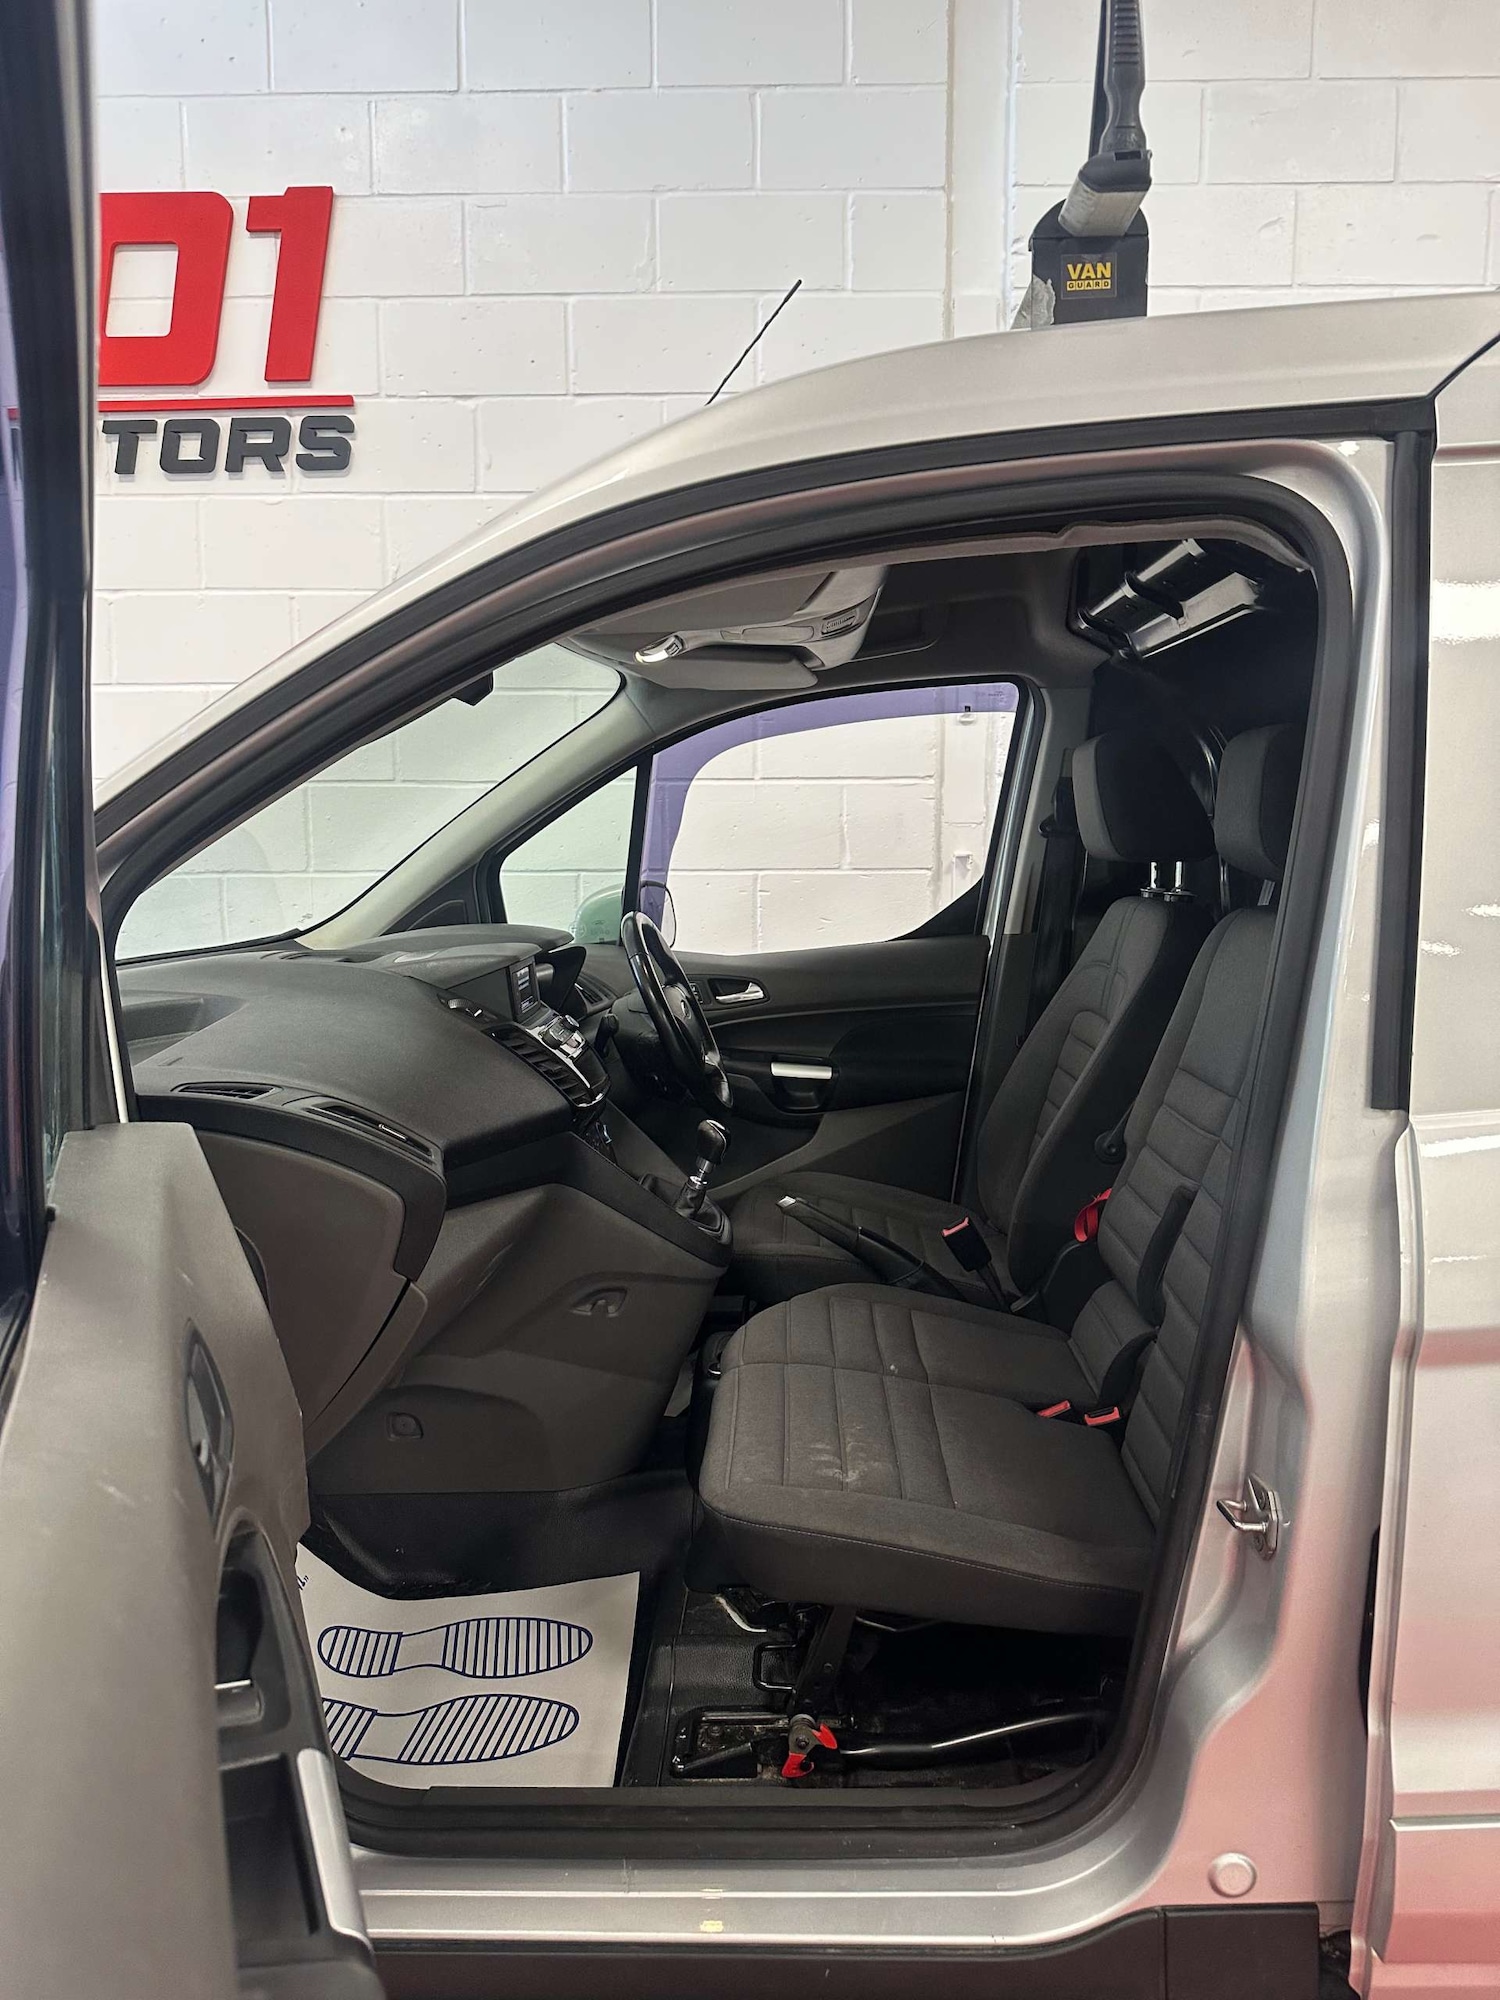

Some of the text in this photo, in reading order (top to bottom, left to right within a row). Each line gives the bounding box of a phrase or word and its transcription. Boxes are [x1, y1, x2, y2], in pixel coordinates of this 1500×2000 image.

[1067, 262, 1111, 279] VAN
[1067, 280, 1111, 290] GUARD
[102, 415, 355, 474] TORS
